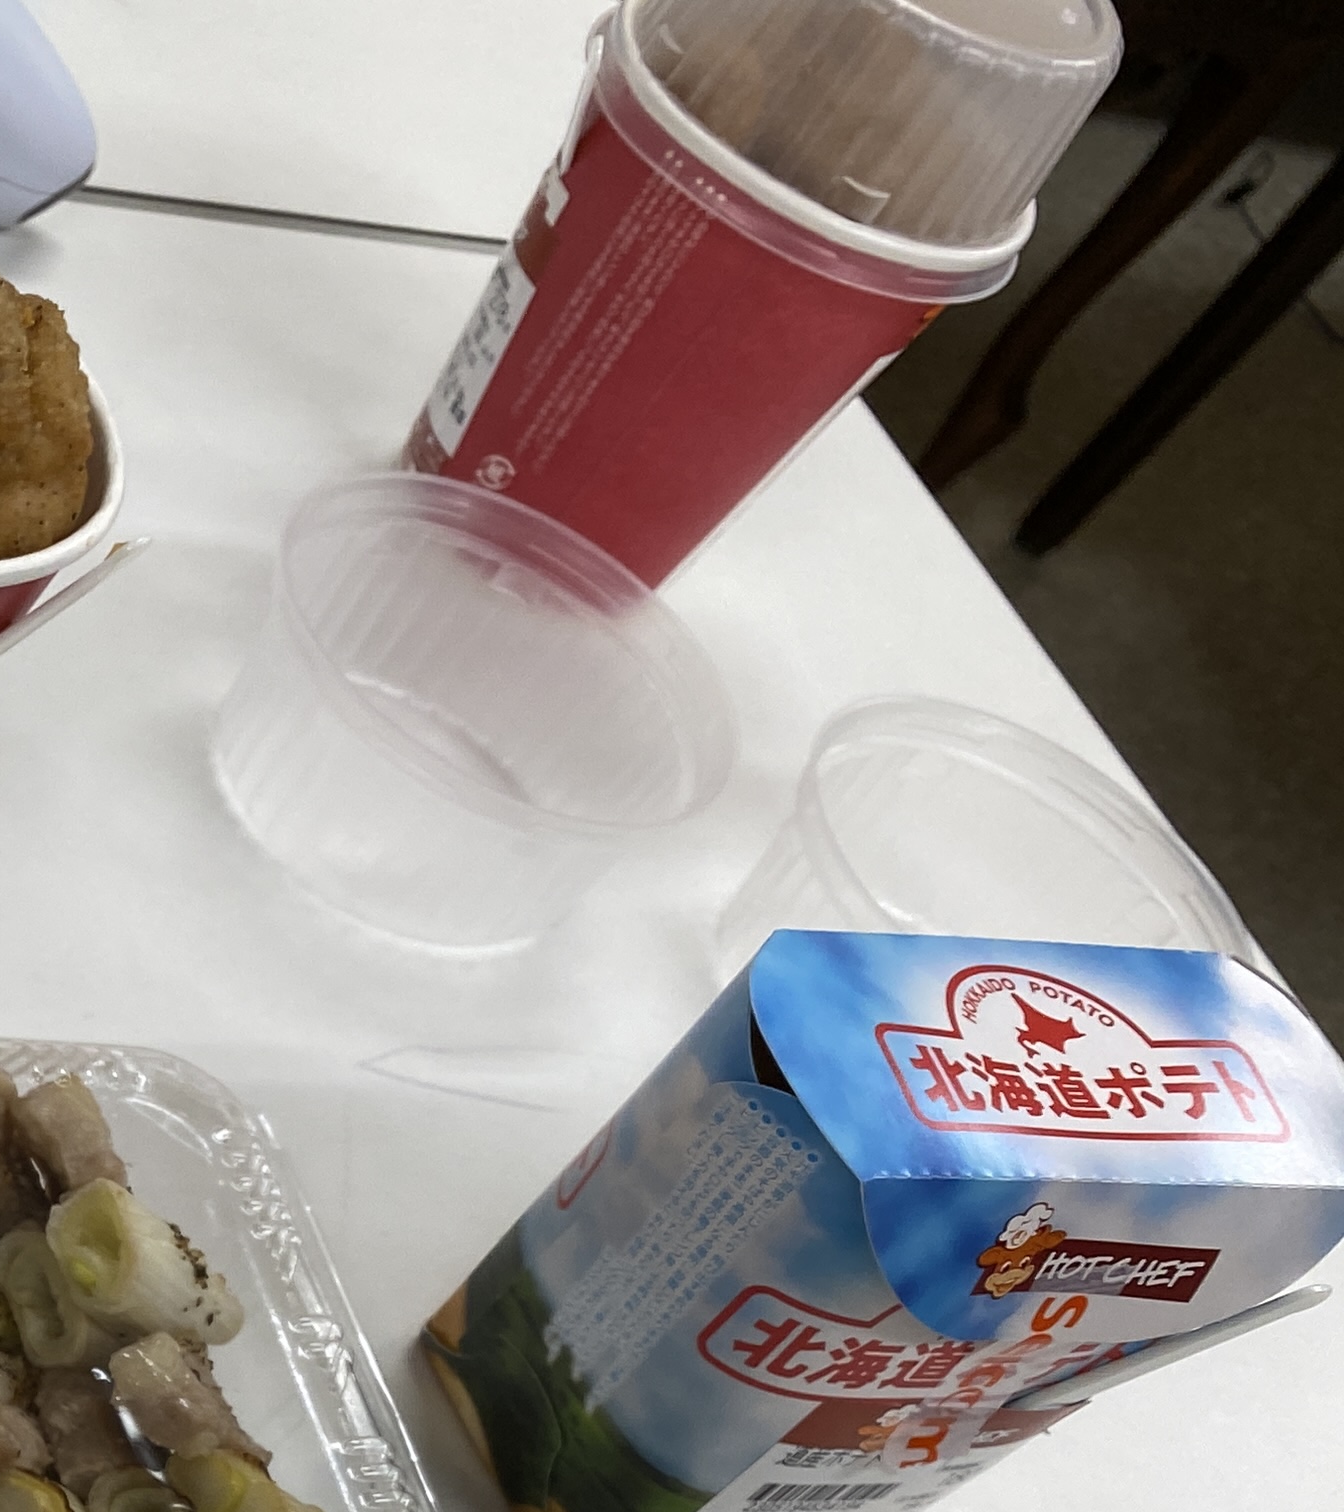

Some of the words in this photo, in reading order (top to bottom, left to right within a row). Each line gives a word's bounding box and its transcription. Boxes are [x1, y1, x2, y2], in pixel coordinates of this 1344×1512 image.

[962, 977, 1017, 1024] HOKKAIDO
[1029, 981, 1116, 1028] POTATO
[908, 1043, 1257, 1122] 北海道ポテト
[1034, 1251, 1115, 1284] HOT
[1107, 1257, 1206, 1288] CHEF
